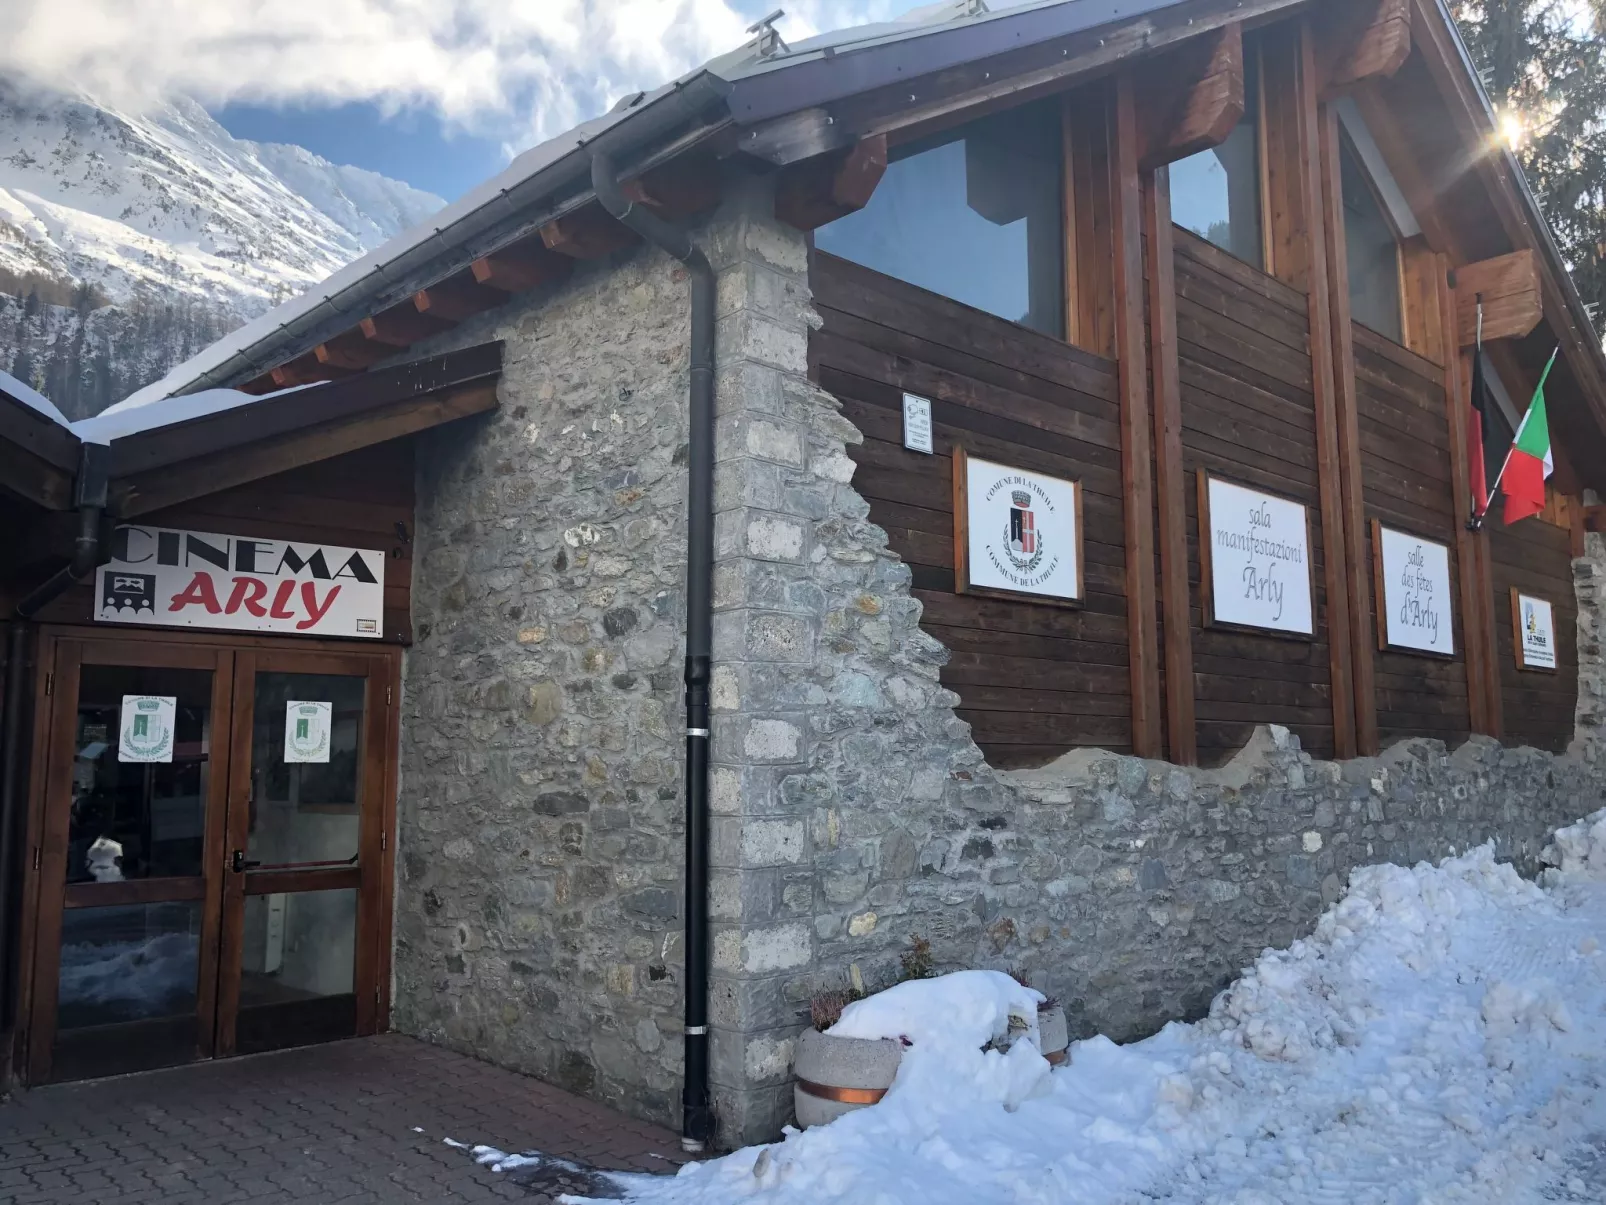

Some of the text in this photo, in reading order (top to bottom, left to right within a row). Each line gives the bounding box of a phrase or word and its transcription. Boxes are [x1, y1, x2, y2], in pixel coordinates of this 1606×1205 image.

[986, 476, 1013, 502] COMUNE
[1014, 476, 1022, 485] DI
[1023, 478, 1032, 488] LA
[1249, 501, 1271, 529] sala
[112, 527, 378, 584] CINEMA
[1217, 526, 1302, 564] manifestazioni
[1408, 545, 1424, 568] salle
[986, 544, 1019, 584] COMMUNE
[1020, 577, 1029, 587] DE
[1402, 564, 1433, 598] des fêtes
[168, 572, 342, 630] ARLY
[1243, 562, 1283, 622] Arly
[1401, 591, 1438, 644] d'Arly
